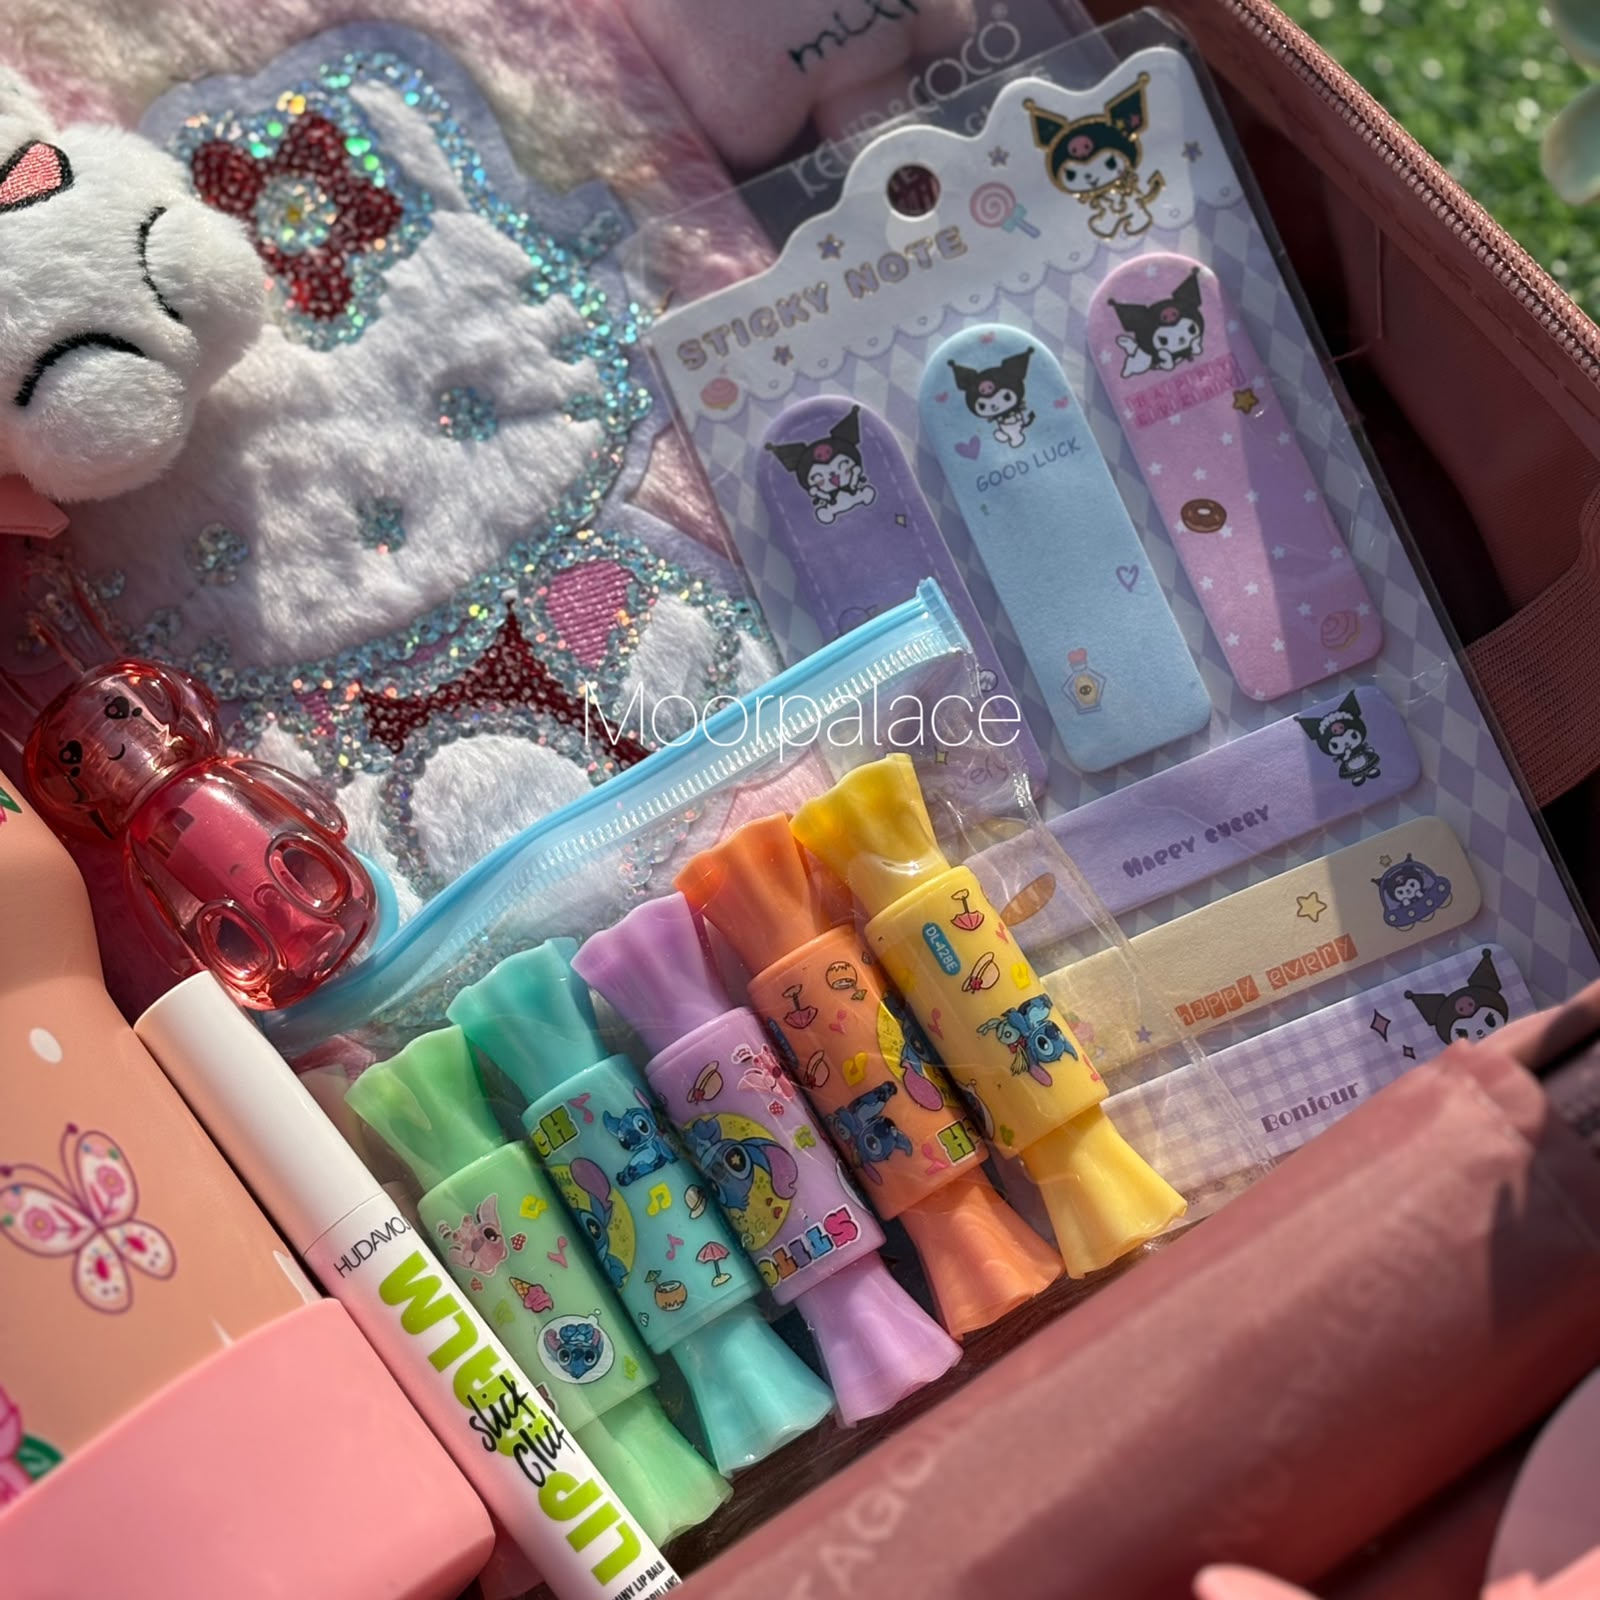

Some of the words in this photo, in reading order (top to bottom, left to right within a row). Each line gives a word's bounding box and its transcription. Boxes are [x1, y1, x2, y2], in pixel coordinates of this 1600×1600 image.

[677, 281, 829, 370] STICKY
[844, 225, 968, 299] NOTE
[975, 459, 1030, 493] GOOD
[1031, 435, 1082, 469] LUCK
[1266, 933, 1359, 990] every
[1261, 1082, 1359, 1132] Bonjour
[538, 1471, 642, 1586] LIP
[632, 1574, 648, 1592] LIP
